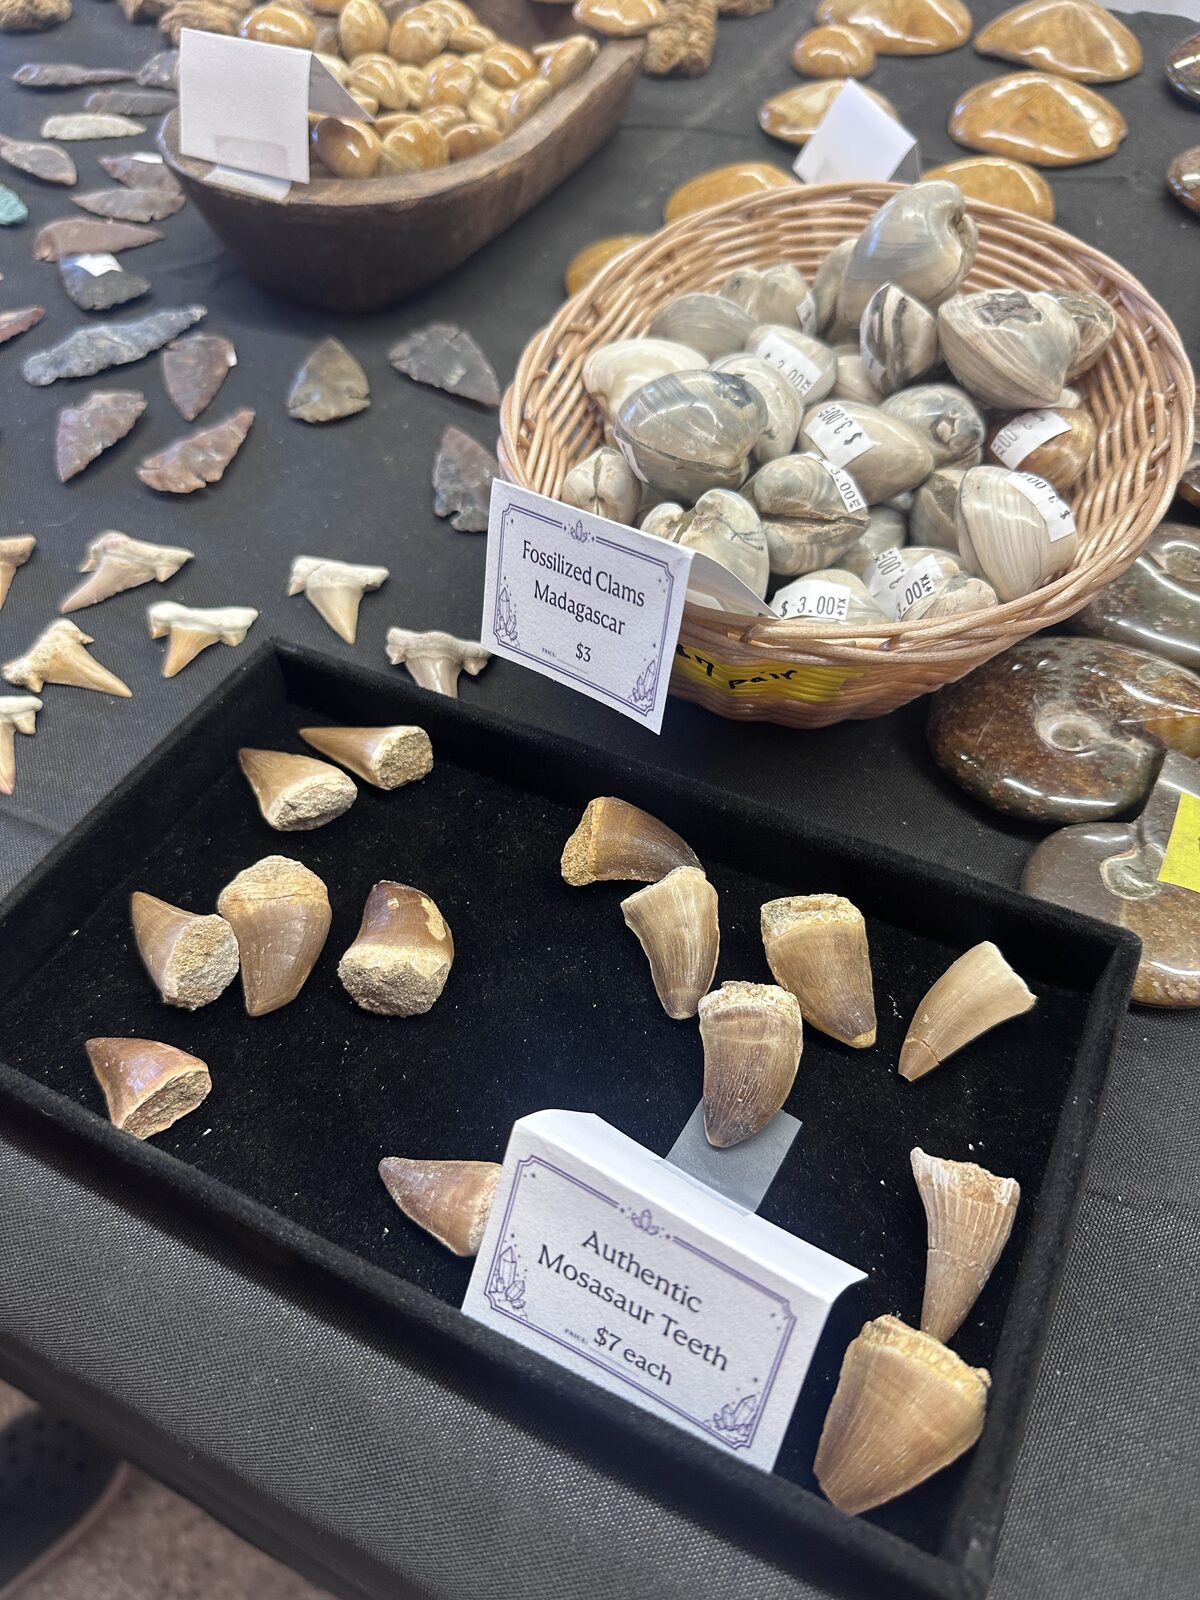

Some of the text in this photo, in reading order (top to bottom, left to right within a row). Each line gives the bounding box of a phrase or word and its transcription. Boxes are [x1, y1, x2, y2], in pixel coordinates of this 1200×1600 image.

[522, 540, 646, 608] Fossilized Clams
[533, 579, 626, 636] Madagascar
[797, 595, 836, 615] 3.00
[575, 641, 592, 663] $3
[582, 1230, 703, 1313] Authentic
[538, 1243, 728, 1372] Mosasaur Teeth
[594, 1326, 623, 1351] $7
[623, 1348, 673, 1386] each
